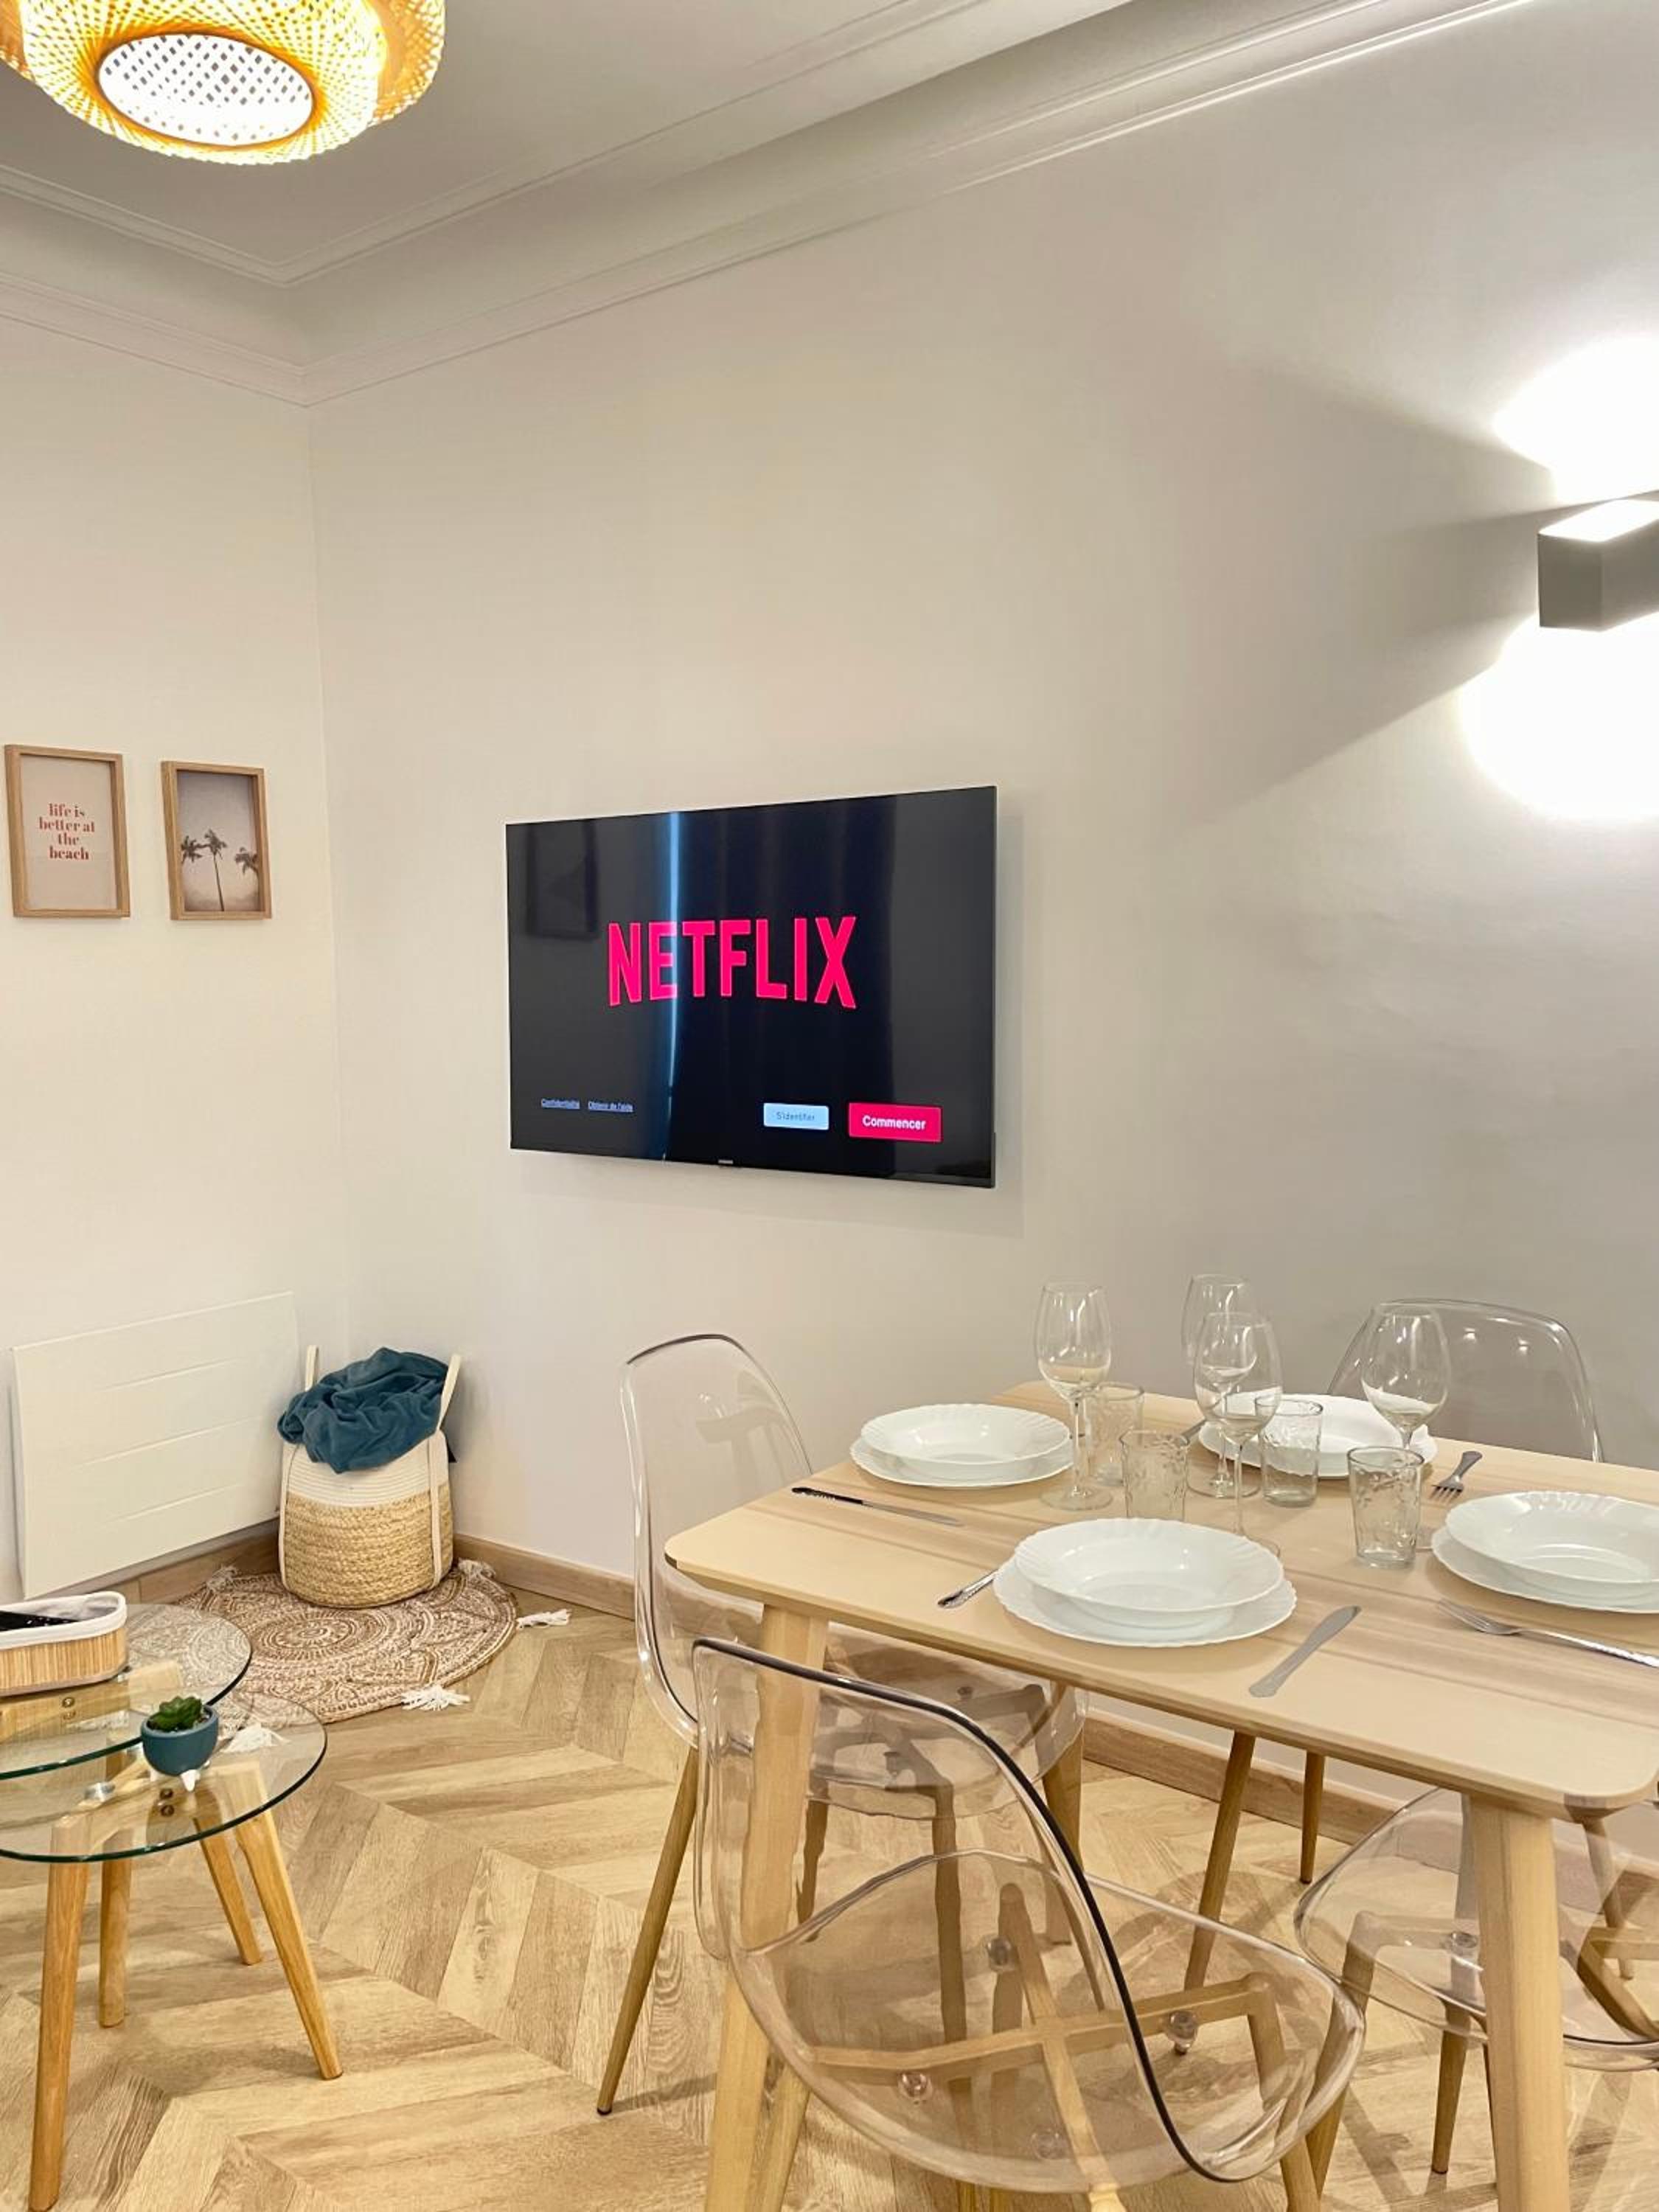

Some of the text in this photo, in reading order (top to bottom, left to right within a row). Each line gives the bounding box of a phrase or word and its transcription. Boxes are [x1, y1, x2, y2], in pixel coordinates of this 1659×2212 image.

[49, 803, 85, 817] life is
[39, 816, 95, 832] better at
[58, 832, 80, 845] the
[49, 846, 89, 860] beach
[608, 917, 857, 1009] NETFLIX
[862, 1115, 926, 1130] Commencer
